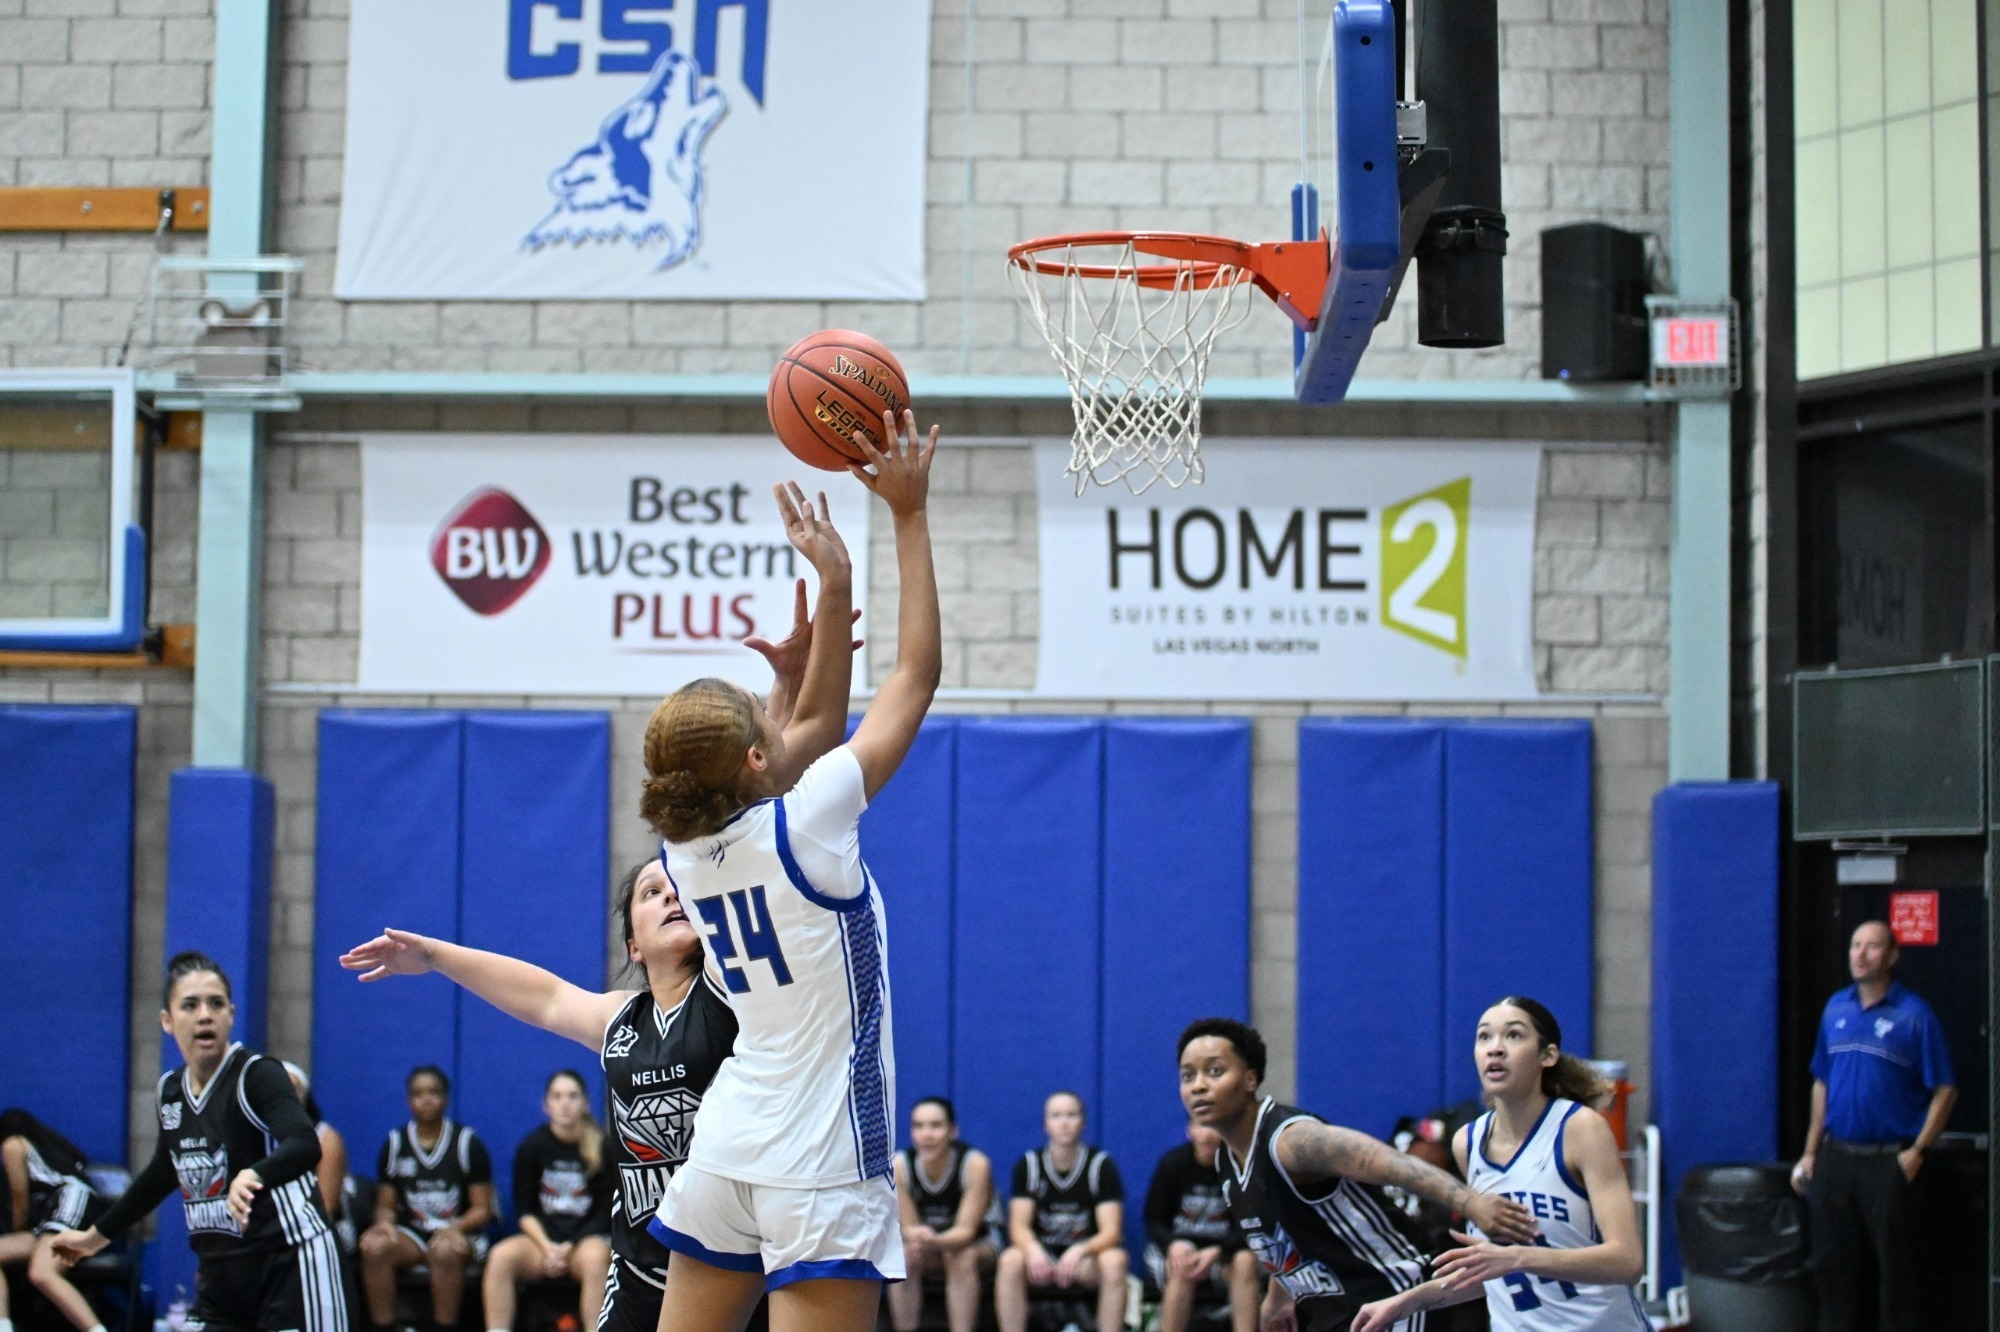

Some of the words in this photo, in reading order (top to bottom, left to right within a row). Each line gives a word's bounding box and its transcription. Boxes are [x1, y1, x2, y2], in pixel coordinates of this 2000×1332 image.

[1668, 320, 1719, 362] EXIT
[628, 475, 749, 524] Best
[446, 527, 538, 580] BW
[572, 531, 798, 577] Western
[1107, 508, 1368, 591] HOME
[1390, 498, 1459, 645] 2
[612, 594, 755, 640] PLUS
[1111, 606, 1206, 625] SUITES
[1222, 606, 1253, 625] BY
[1270, 606, 1370, 625] HILTON
[1153, 638, 1187, 655] LAS
[1190, 638, 1250, 655] VEGAS
[1255, 638, 1320, 655] NORTH
[693, 885, 794, 994] 24
[631, 1064, 687, 1087] NELLIS
